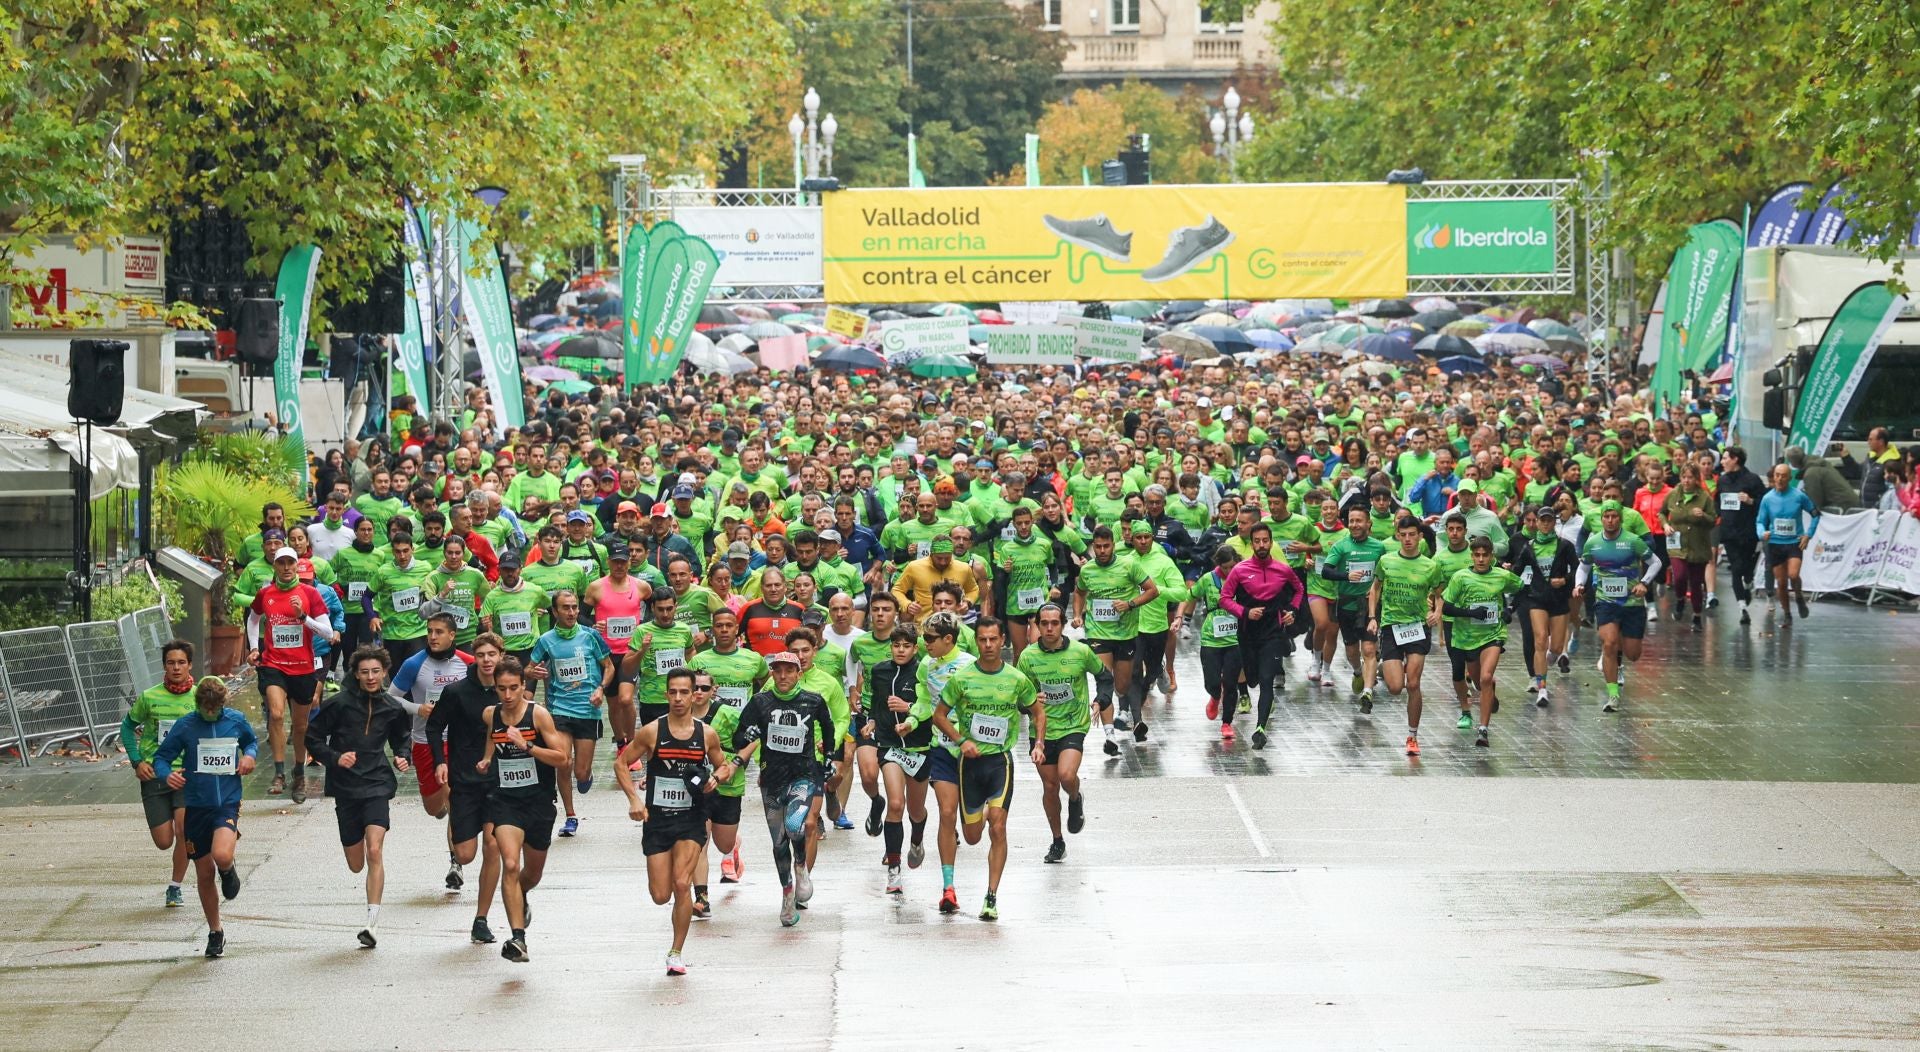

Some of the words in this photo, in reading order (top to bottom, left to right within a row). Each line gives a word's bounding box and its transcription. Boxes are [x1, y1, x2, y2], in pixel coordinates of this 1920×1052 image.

[862, 207, 980, 226] Valladolid
[696, 232, 740, 240] ntamiento
[862, 236, 894, 252] en
[898, 232, 986, 250] marcha
[1454, 227, 1548, 247] Iberdrola
[862, 269, 938, 285] contra
[944, 266, 966, 284] el
[972, 266, 1052, 284] cáncer
[1692, 248, 1718, 323] erdrola
[655, 262, 682, 340] Iberdrola
[668, 259, 707, 338] Iberdrola
[904, 322, 930, 331] RIOSECO
[932, 322, 936, 330] Y
[937, 318, 966, 330] COMARCA
[1080, 322, 1105, 332] RIOSECO
[1112, 326, 1142, 336] COMARCA
[919, 334, 927, 343] EN
[929, 332, 954, 342] MARCHA
[1092, 335, 1100, 344] EN
[1102, 336, 1128, 347] MARCHA
[988, 334, 1030, 355] PROHIBIDO
[1038, 334, 1073, 355] RENDIRSE
[1079, 346, 1104, 357] CONTRA
[1805, 395, 1820, 429] contra
[1817, 384, 1825, 397] el
[1823, 353, 1841, 384] cáncer
[1810, 422, 1818, 434] en
[1815, 372, 1841, 424] Valladolid
[400, 596, 416, 606] 4782
[674, 610, 693, 620] aecc
[506, 621, 527, 631] 50118
[612, 625, 632, 634] 27101
[276, 634, 300, 643] 39699
[1399, 628, 1420, 640] 14755
[559, 667, 582, 676] 30491
[980, 700, 1017, 711] marcha
[978, 726, 1000, 737] 8057
[772, 734, 800, 747] 56080
[203, 756, 231, 766] 52524
[503, 770, 531, 781] 50130
[662, 789, 685, 800] 11811
